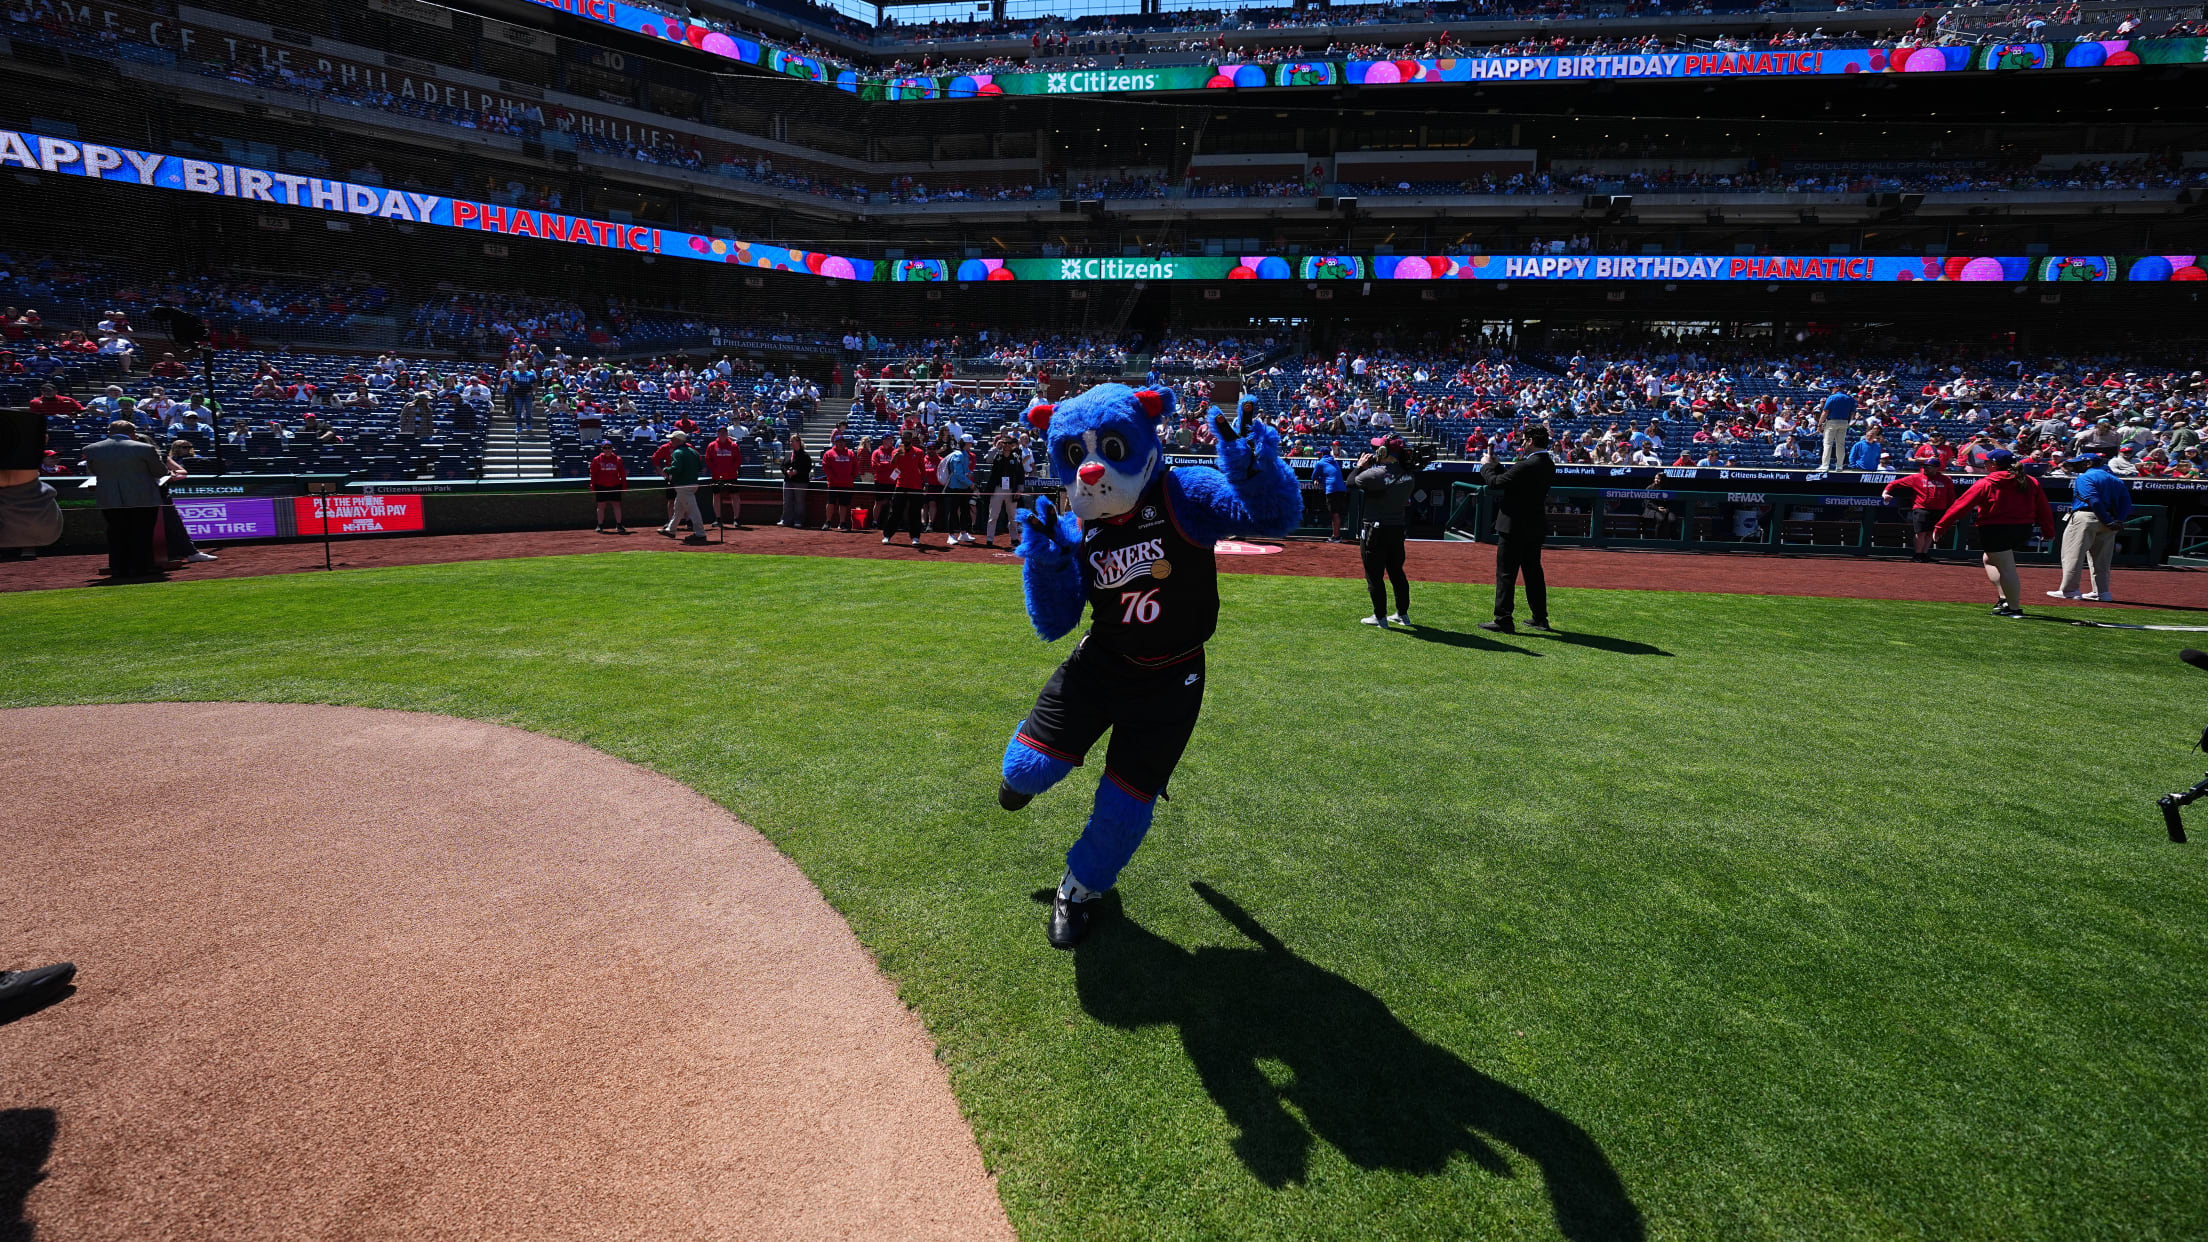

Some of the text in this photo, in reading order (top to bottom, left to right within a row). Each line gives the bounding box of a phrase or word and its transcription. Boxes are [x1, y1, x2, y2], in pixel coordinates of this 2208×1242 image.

[1470, 52, 1822, 79] HAPPY BIRTHDAY PHANATIC!
[1070, 72, 1155, 92] Citizens
[0, 129, 661, 254] APPY BIRTHDAY PHANATIC!
[1085, 259, 1173, 279] Citizens
[1505, 257, 1875, 279] HAPPY BIRTHDAY PHANATIC!
[1730, 471, 1757, 479] Citizens
[1758, 472, 1774, 480] Bank
[168, 486, 244, 495] HILLIES.COM
[434, 484, 452, 492] Park
[1606, 490, 1660, 499] smartwater
[333, 497, 351, 506] THE
[1825, 497, 1881, 507] smartwater
[336, 504, 407, 517] AWAY OR PAY
[214, 522, 257, 534] TIRE
[342, 522, 384, 532] NHTSA
[1120, 587, 1161, 624] 76
